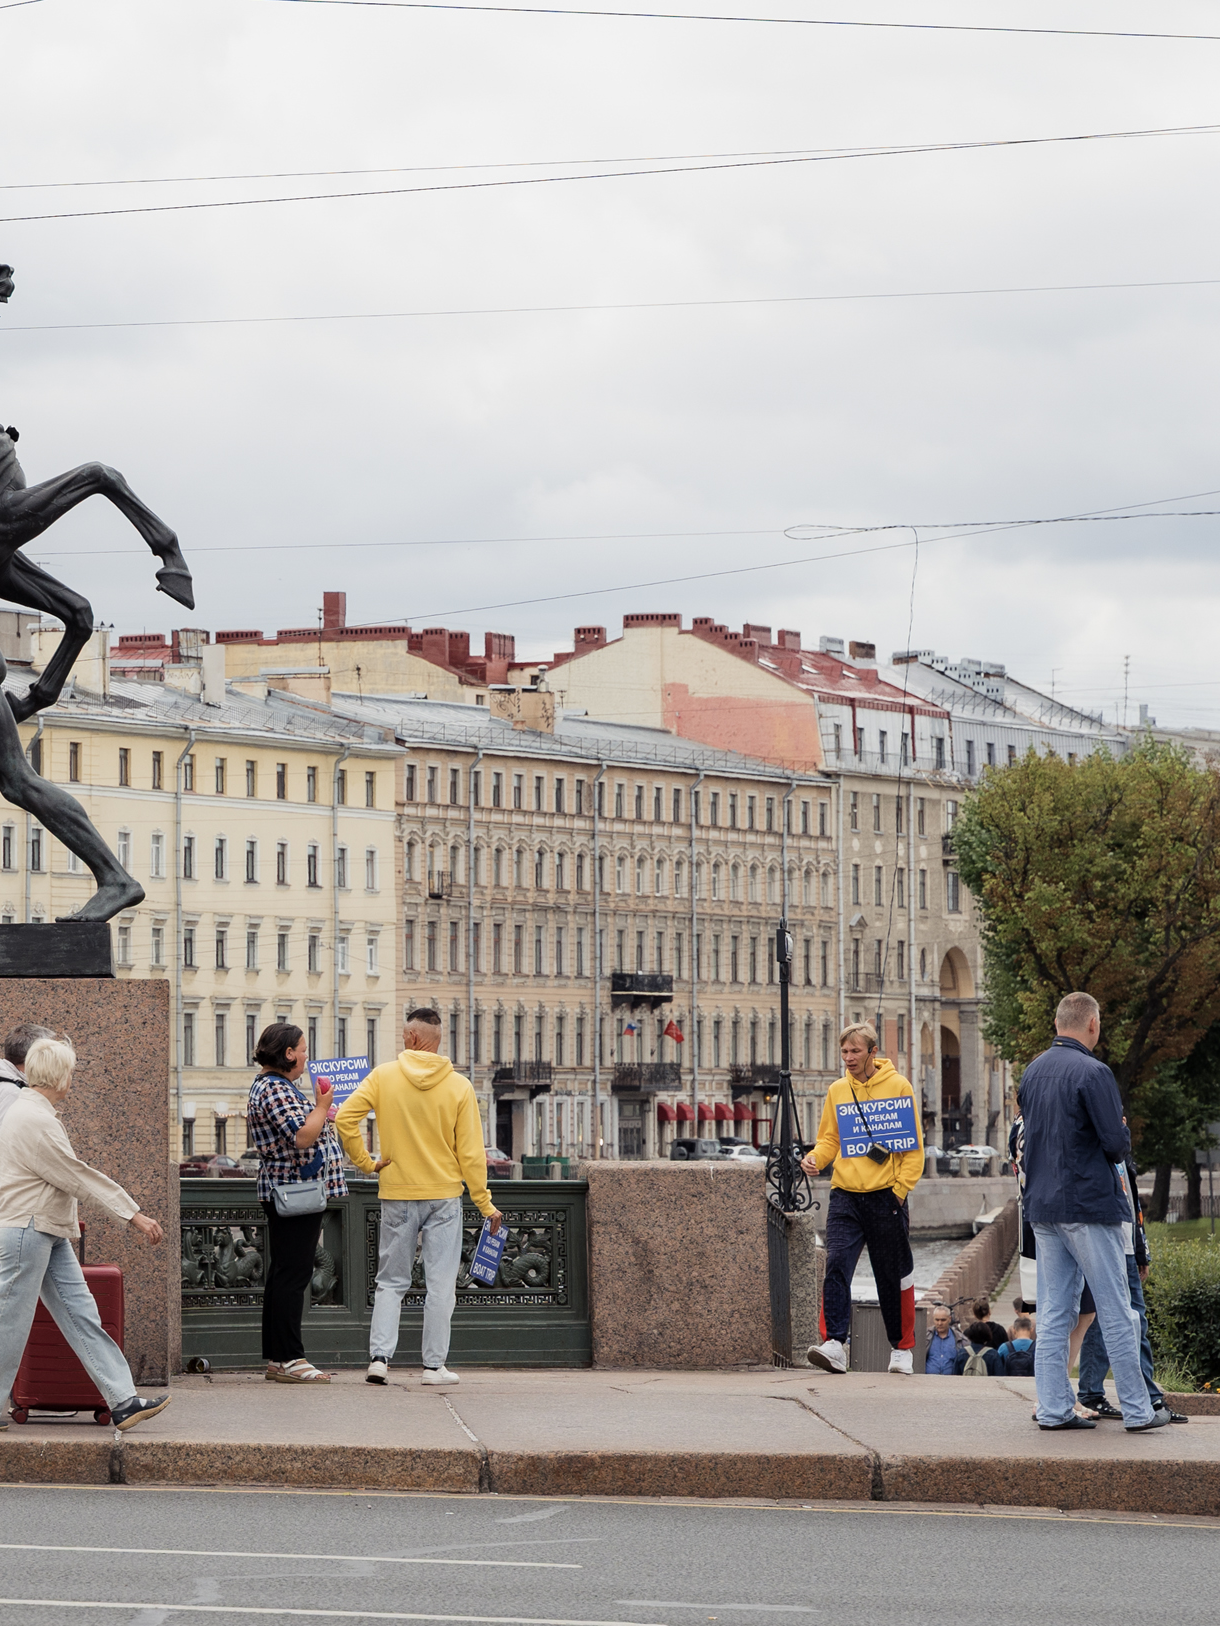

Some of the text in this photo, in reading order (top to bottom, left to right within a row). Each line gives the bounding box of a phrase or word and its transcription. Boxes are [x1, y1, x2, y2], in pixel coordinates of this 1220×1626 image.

[309, 1058, 368, 1074] ЭКСКУРСИИ
[335, 1072, 359, 1082] РЕКАМ
[839, 1098, 911, 1116] ЭКСКУРСИИ
[869, 1112, 898, 1123] РЕКАМ
[853, 1126, 860, 1134] И
[885, 1137, 915, 1152] TRIP
[473, 1262, 486, 1277] BOAT
